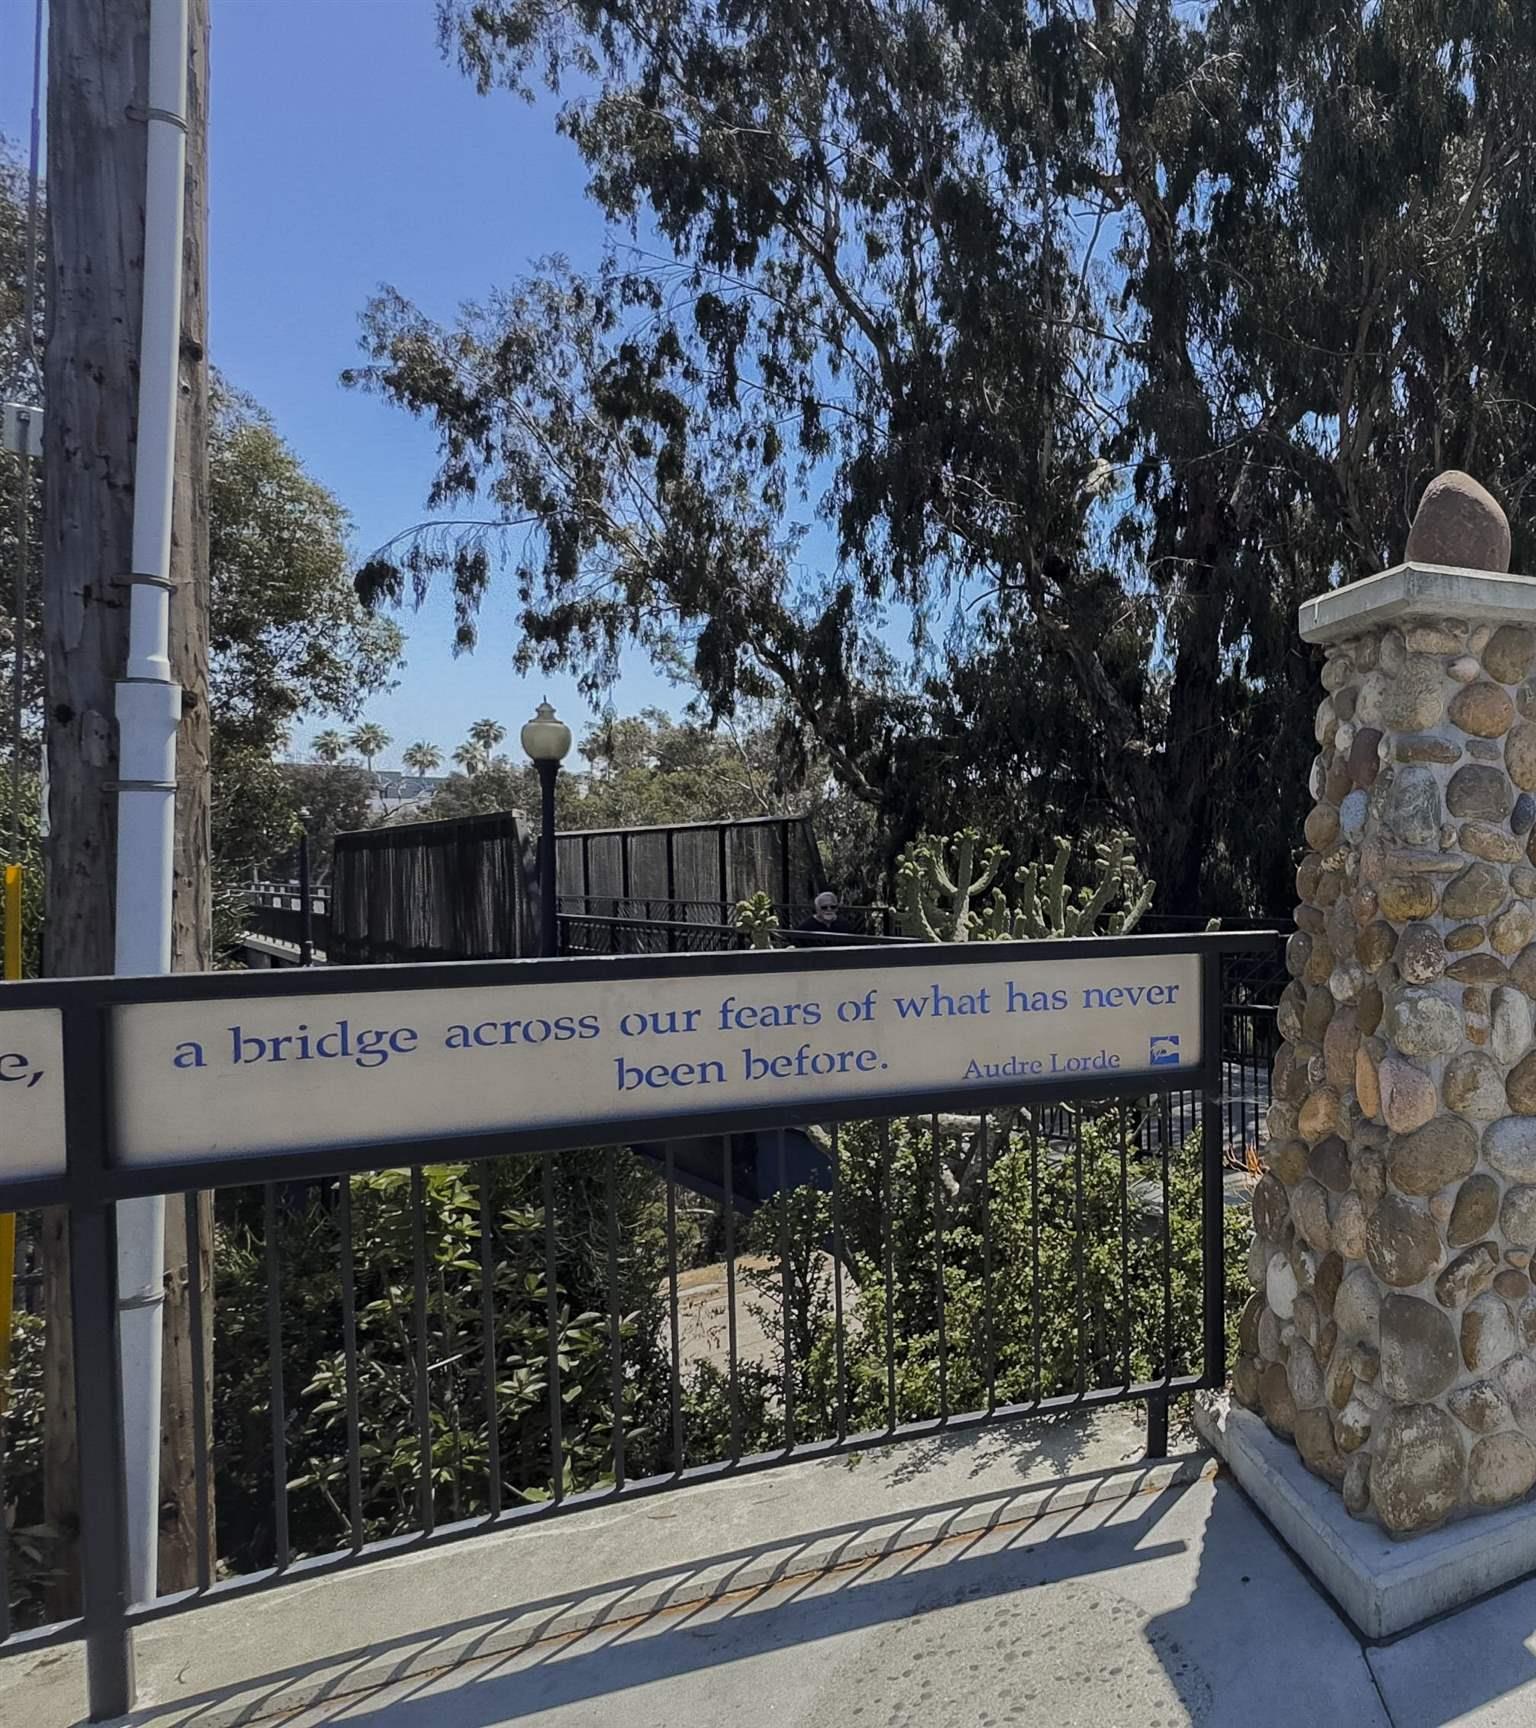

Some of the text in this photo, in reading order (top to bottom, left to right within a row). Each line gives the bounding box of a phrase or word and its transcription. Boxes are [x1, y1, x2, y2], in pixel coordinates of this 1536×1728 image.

[172, 981, 1180, 1069] a bridge across our fears of what has never
[614, 1044, 888, 1091] been before.
[963, 1050, 1121, 1080] Audre Lorde
